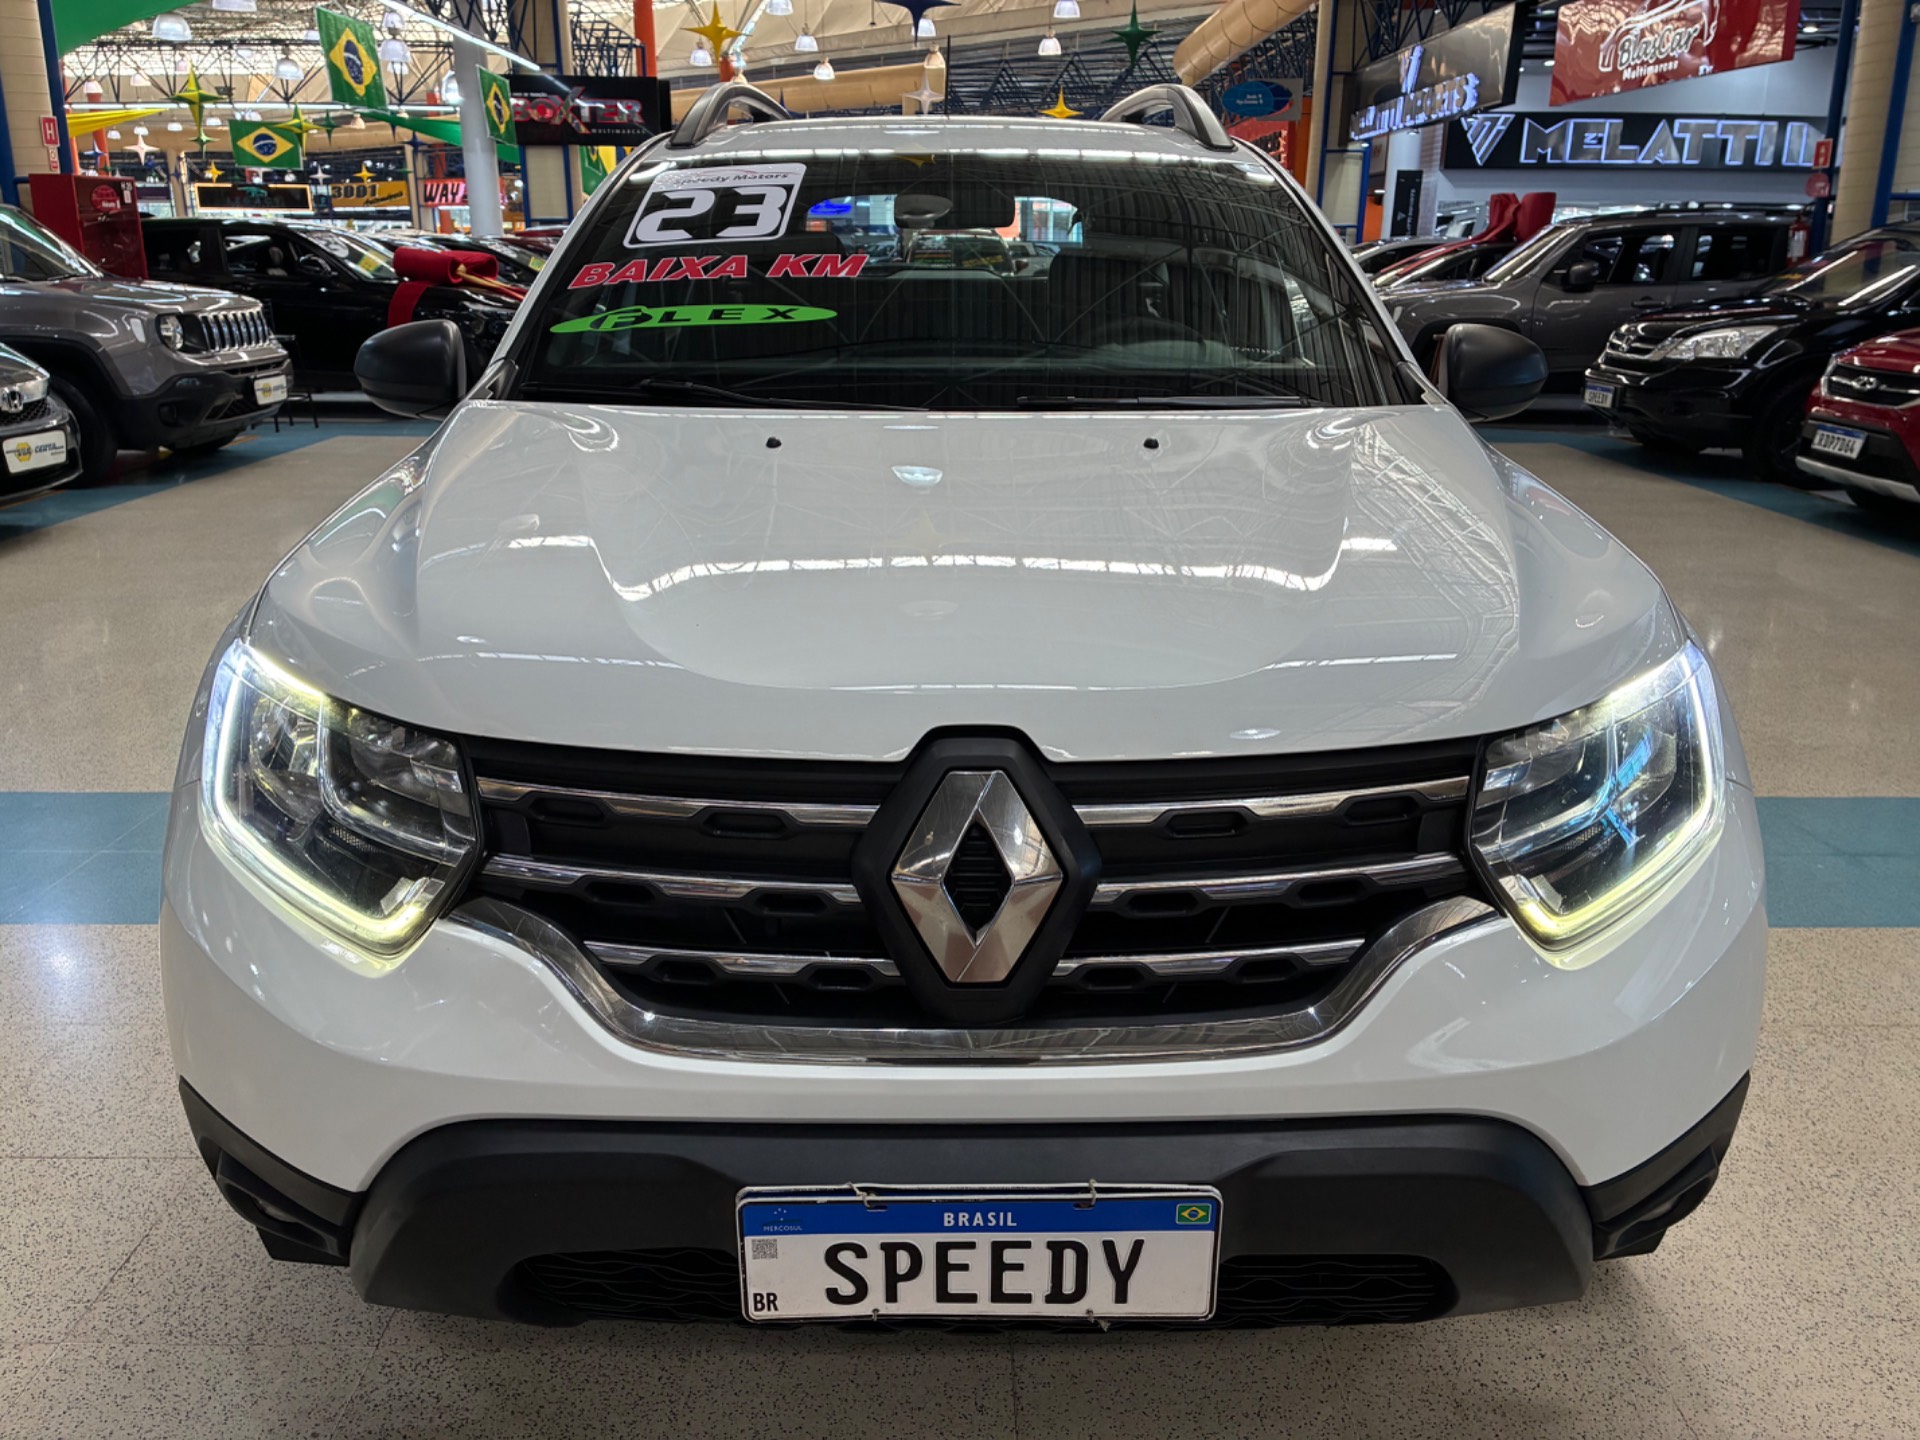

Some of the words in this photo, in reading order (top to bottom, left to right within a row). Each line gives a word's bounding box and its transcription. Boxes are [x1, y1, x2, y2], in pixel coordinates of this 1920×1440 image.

[45, 122, 55, 140] H
[1519, 118, 1779, 165] MELATTI
[734, 172, 789, 182] Motors
[331, 183, 379, 199] 3001
[424, 183, 462, 203] WAY
[636, 186, 788, 242] 23
[568, 255, 748, 290] BAIXA
[765, 253, 870, 278] KM
[599, 306, 796, 328] FLEX
[943, 1212, 1018, 1228] BRASIL
[823, 1238, 1145, 1306] SPEEDY
[753, 1292, 779, 1311] BR
